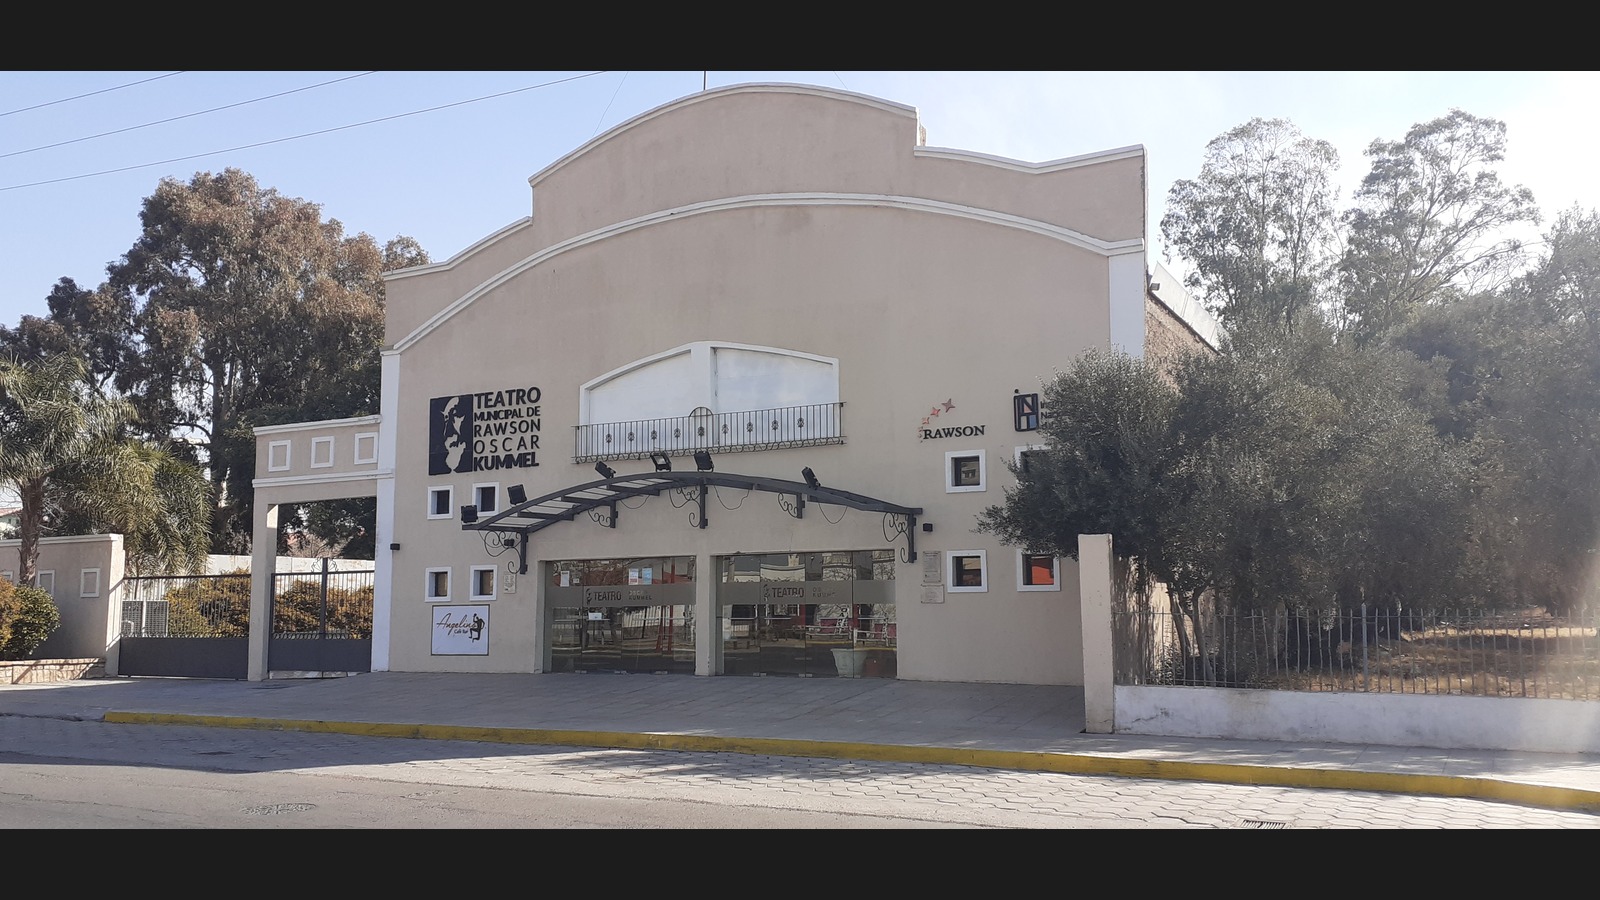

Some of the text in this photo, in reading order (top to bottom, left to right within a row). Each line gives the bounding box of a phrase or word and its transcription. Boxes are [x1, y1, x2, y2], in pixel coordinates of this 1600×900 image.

[474, 387, 541, 409] TEATRO
[526, 406, 541, 417] DE
[474, 419, 541, 437] RAWSON
[922, 425, 985, 439] RAWSON
[474, 435, 540, 454] OSCAR
[474, 452, 539, 471] KUMMEL
[593, 591, 622, 601] TEATRO
[772, 587, 805, 598] TEATRO
